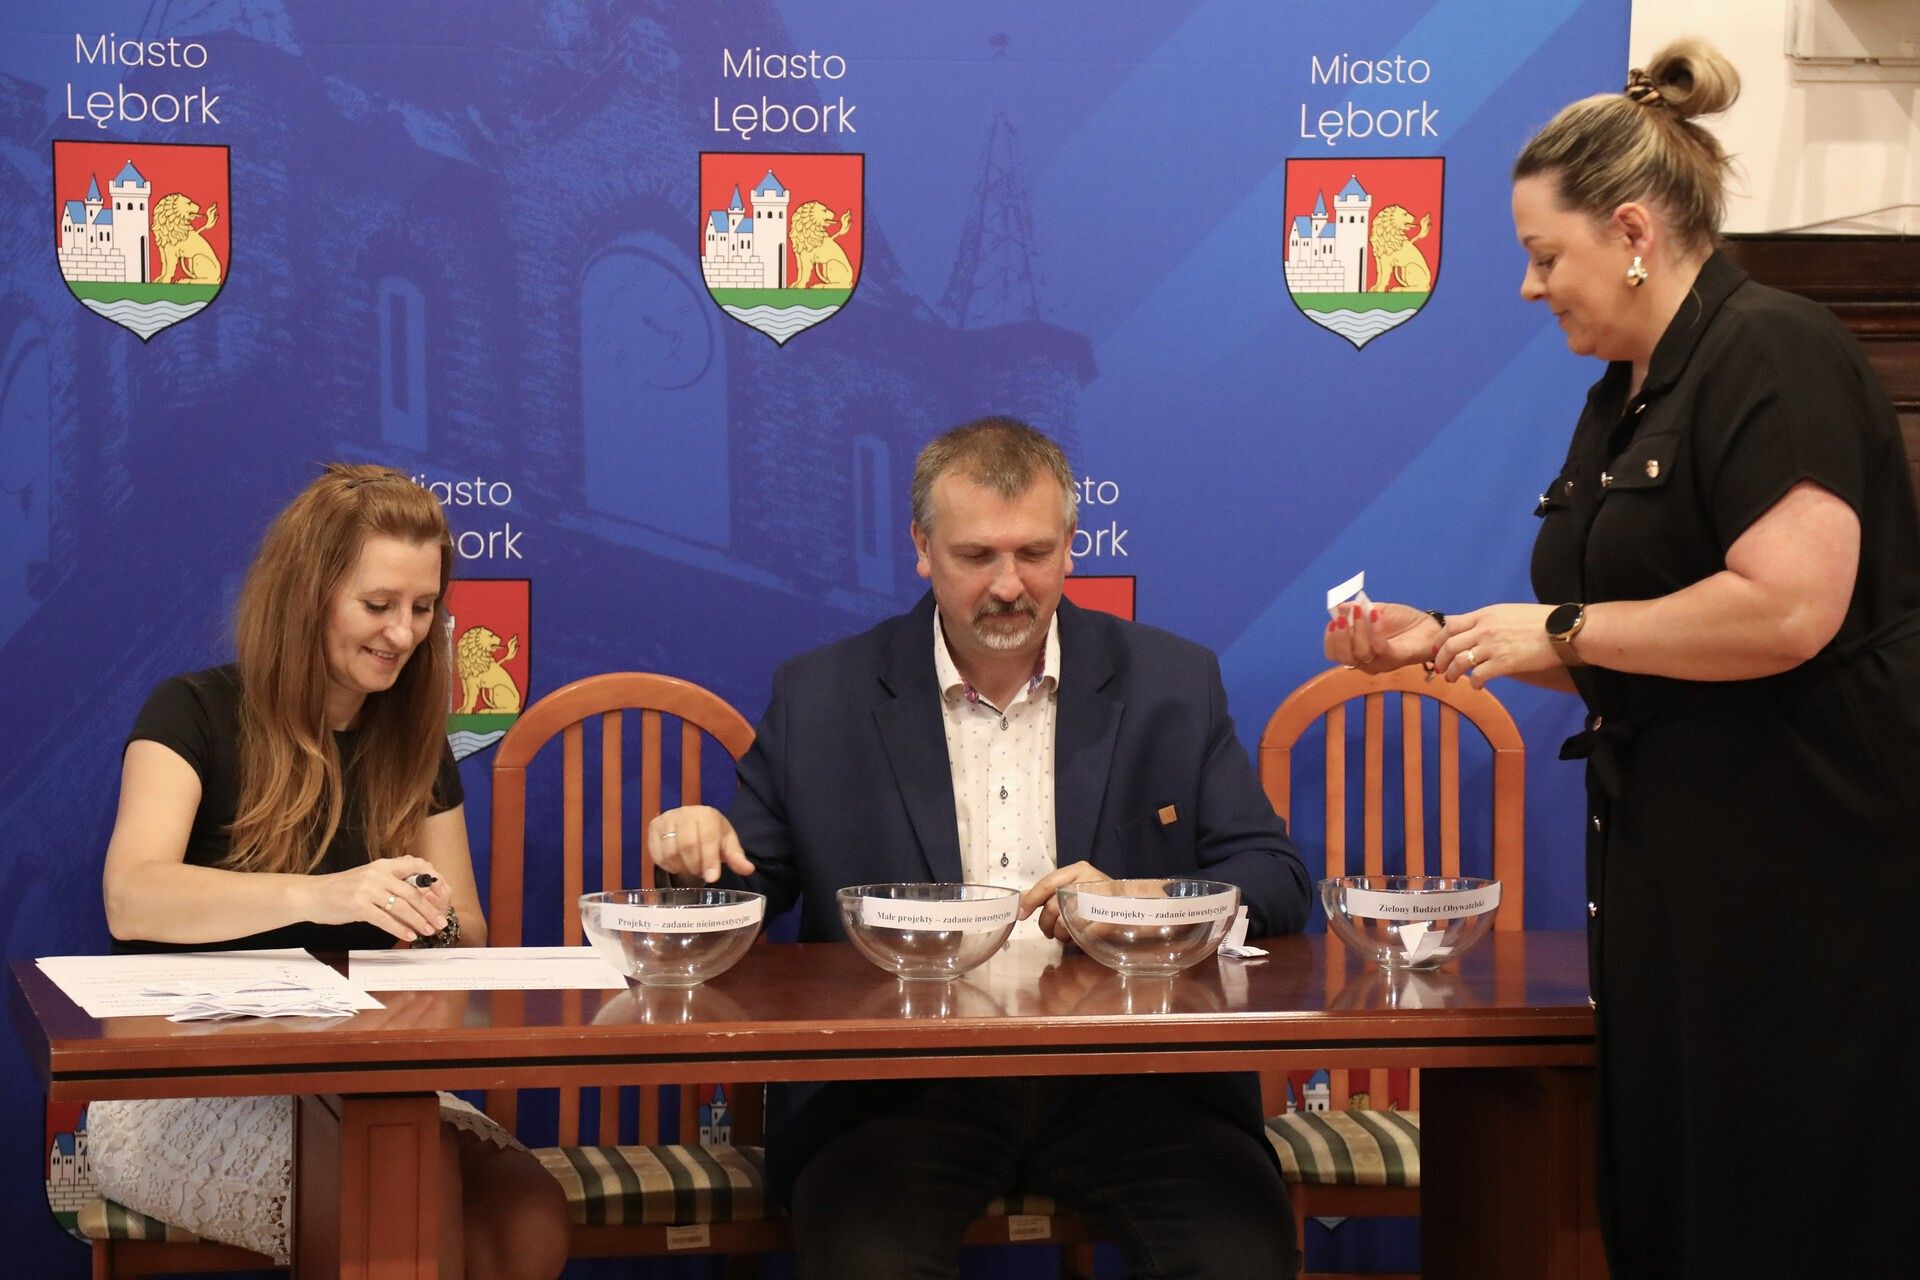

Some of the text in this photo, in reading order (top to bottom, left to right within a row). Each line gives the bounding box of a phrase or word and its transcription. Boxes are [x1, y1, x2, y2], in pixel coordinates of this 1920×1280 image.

[75, 33, 208, 69] Miasto
[722, 47, 847, 80] Miasto
[1311, 53, 1431, 85] Miasto
[66, 83, 221, 129] Lębork
[713, 96, 857, 141] Lębork
[1300, 101, 1439, 147] Lębork
[411, 474, 512, 507] iasto
[1074, 475, 1120, 506] sto
[452, 522, 524, 560] ork
[1070, 520, 1129, 558] ork
[617, 917, 652, 929] Projekty
[661, 921, 694, 929] zadanie
[696, 914, 751, 929] nieinwestycyjne
[898, 913, 933, 925] projekty
[942, 914, 973, 924] zadanie
[974, 909, 1012, 923] inwestycyjne
[1091, 906, 1109, 916] Duże
[1110, 909, 1146, 921] projekty
[1155, 910, 1186, 919] zadanie
[1187, 904, 1228, 918] inwestycyjne
[1378, 898, 1485, 915] Zielony Budżet Obywatelski
